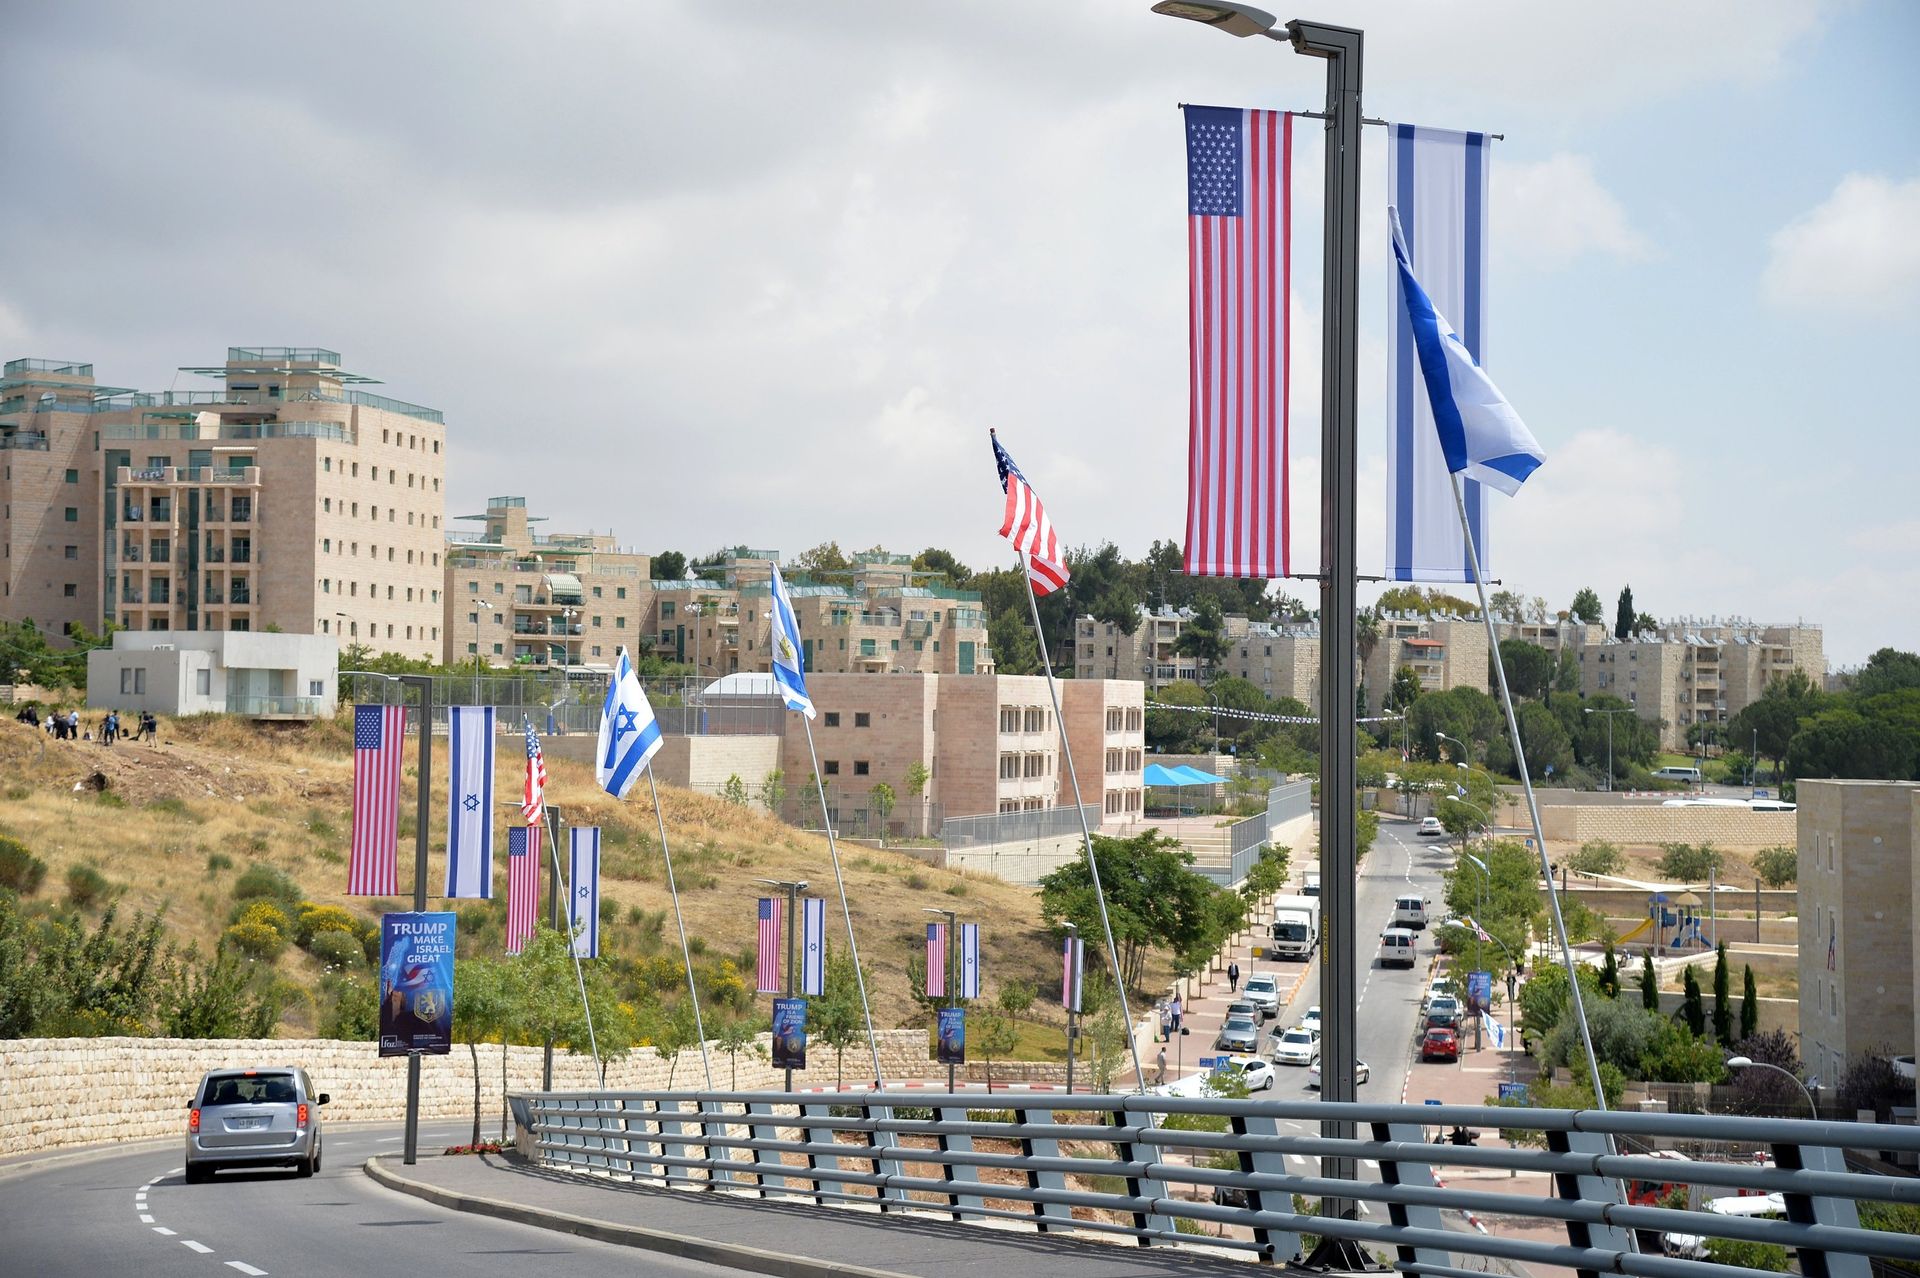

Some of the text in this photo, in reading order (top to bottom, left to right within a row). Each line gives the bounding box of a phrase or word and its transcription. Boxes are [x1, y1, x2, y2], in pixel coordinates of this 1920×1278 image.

[391, 922, 448, 935] TRUMP
[413, 935, 444, 944] MAKE
[416, 945, 451, 953] ISRAEL
[407, 954, 440, 963] GREAT
